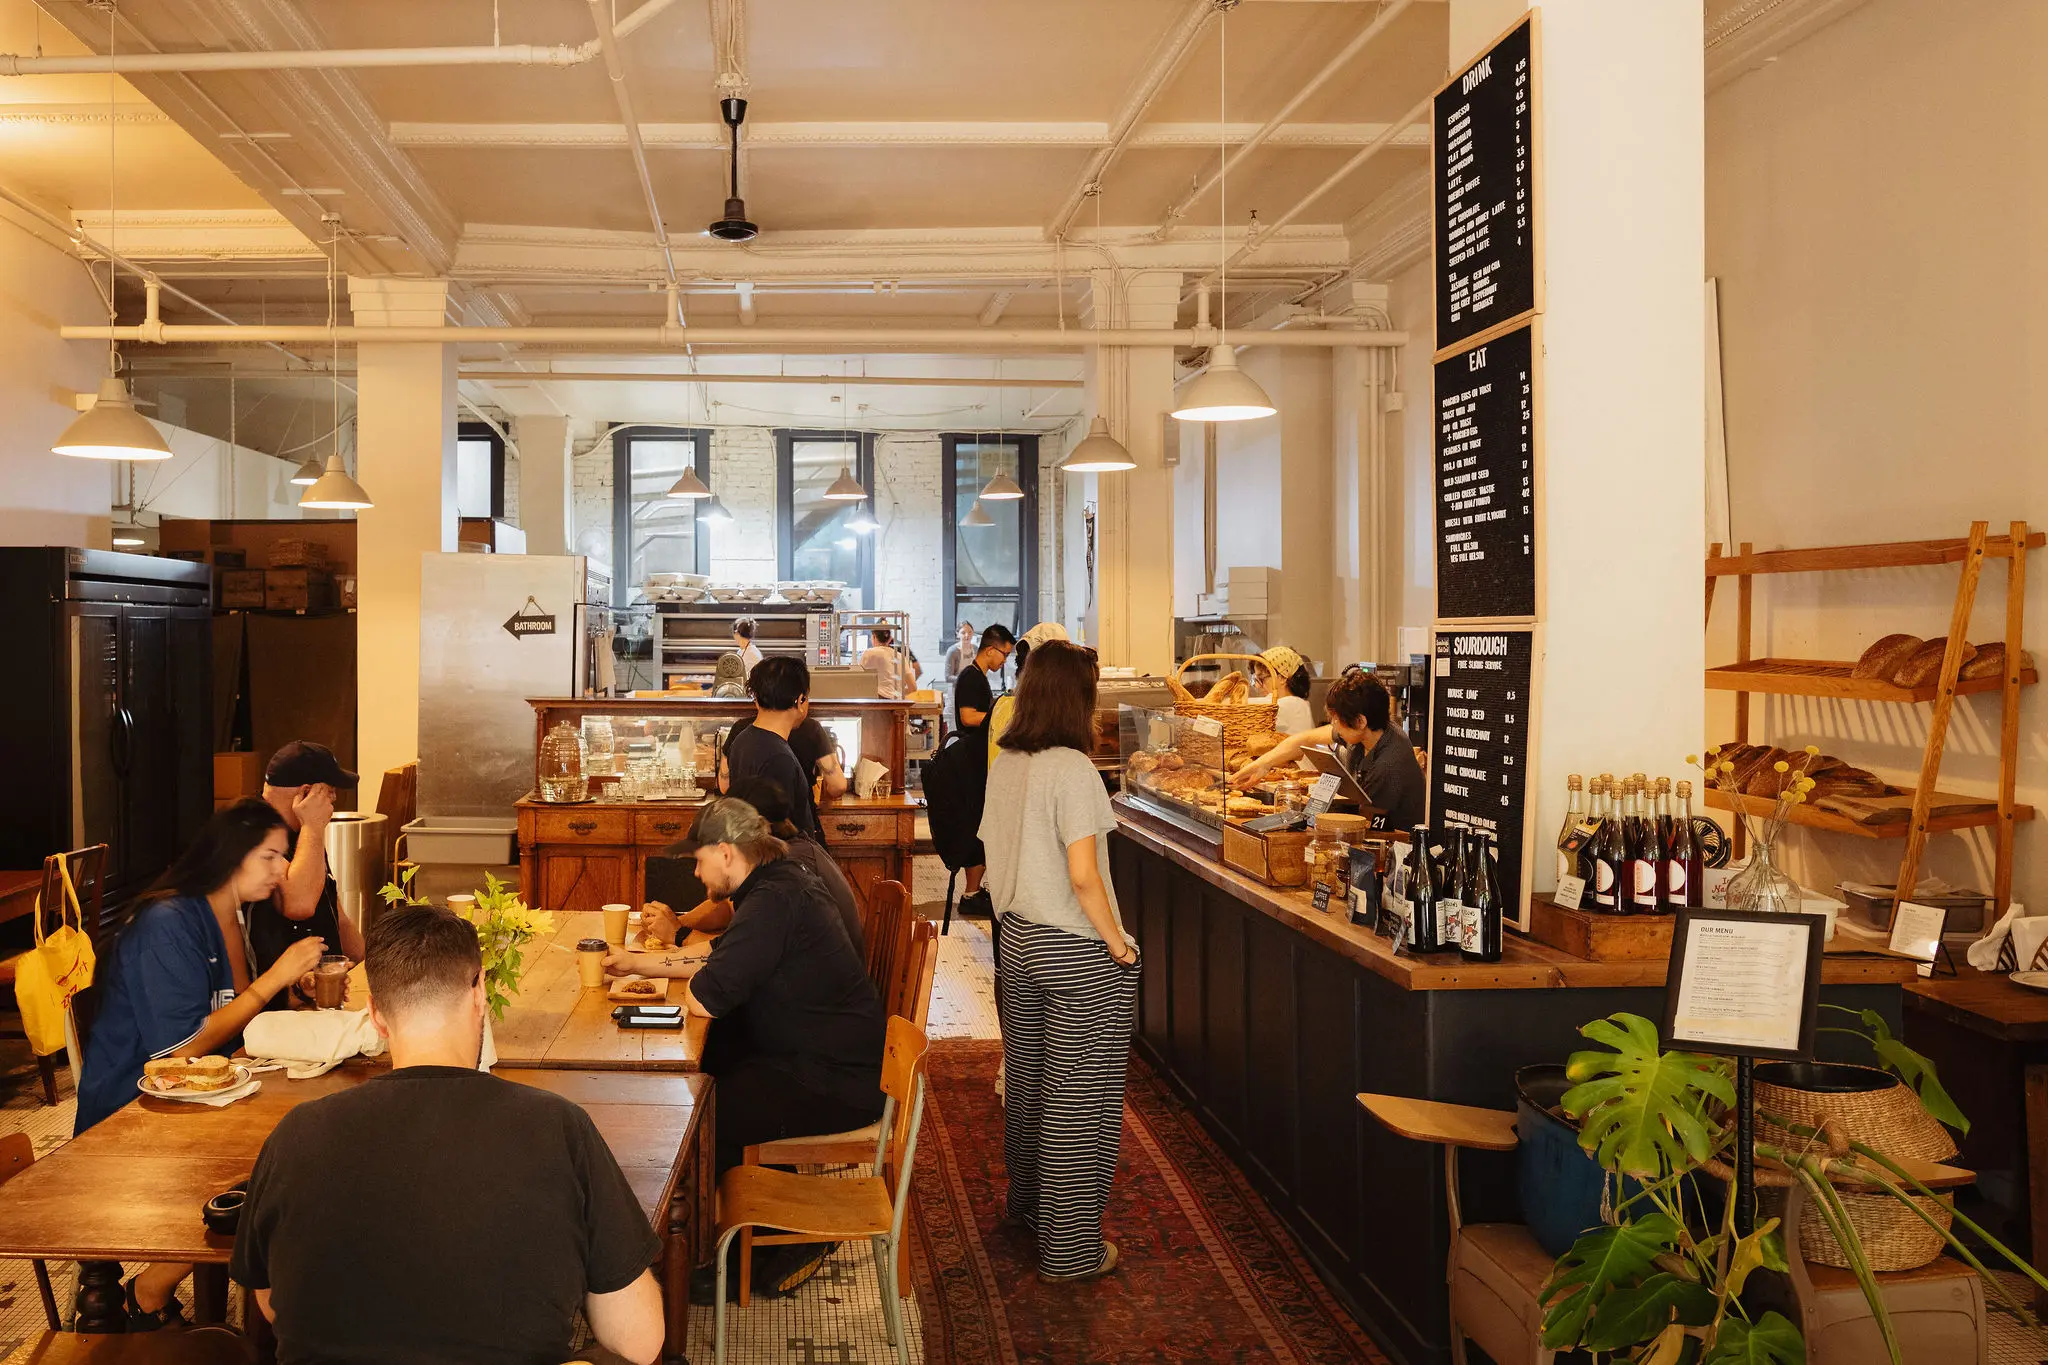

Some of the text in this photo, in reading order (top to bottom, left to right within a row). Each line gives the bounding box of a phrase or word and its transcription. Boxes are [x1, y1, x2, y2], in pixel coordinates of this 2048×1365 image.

[1462, 56, 1492, 95] DRINK
[1516, 120, 1520, 129] 5
[1448, 150, 1459, 165] FLAT
[1448, 175, 1462, 190] LATTE
[1465, 176, 1480, 192] COFFEE
[1492, 200, 1505, 216] LATTE
[1476, 225, 1488, 238] LATTE
[1466, 247, 1475, 258] TEA
[1477, 238, 1490, 252] LATTE
[1449, 272, 1457, 282] TEA
[1469, 347, 1487, 372] EAT
[1462, 488, 1476, 498] CHEESE
[1450, 544, 1461, 553] FULL
[514, 622, 551, 630] BATHROOM
[1454, 636, 1507, 656] SOURDOUGH
[1448, 688, 1515, 700] HOUSE LOAF 9.5
[1446, 707, 1468, 719] TOASTED
[1471, 710, 1484, 720] SEED
[1446, 726, 1509, 744] OLIVE & ROSEMARY 12
[1458, 748, 1478, 759] WALNUT
[1504, 756, 1513, 765] 12.5
[1445, 764, 1457, 775] DARK
[1460, 767, 1486, 781] CHOCOLATE
[1444, 783, 1468, 797] BAGUETTE
[1372, 817, 1385, 829] 21
